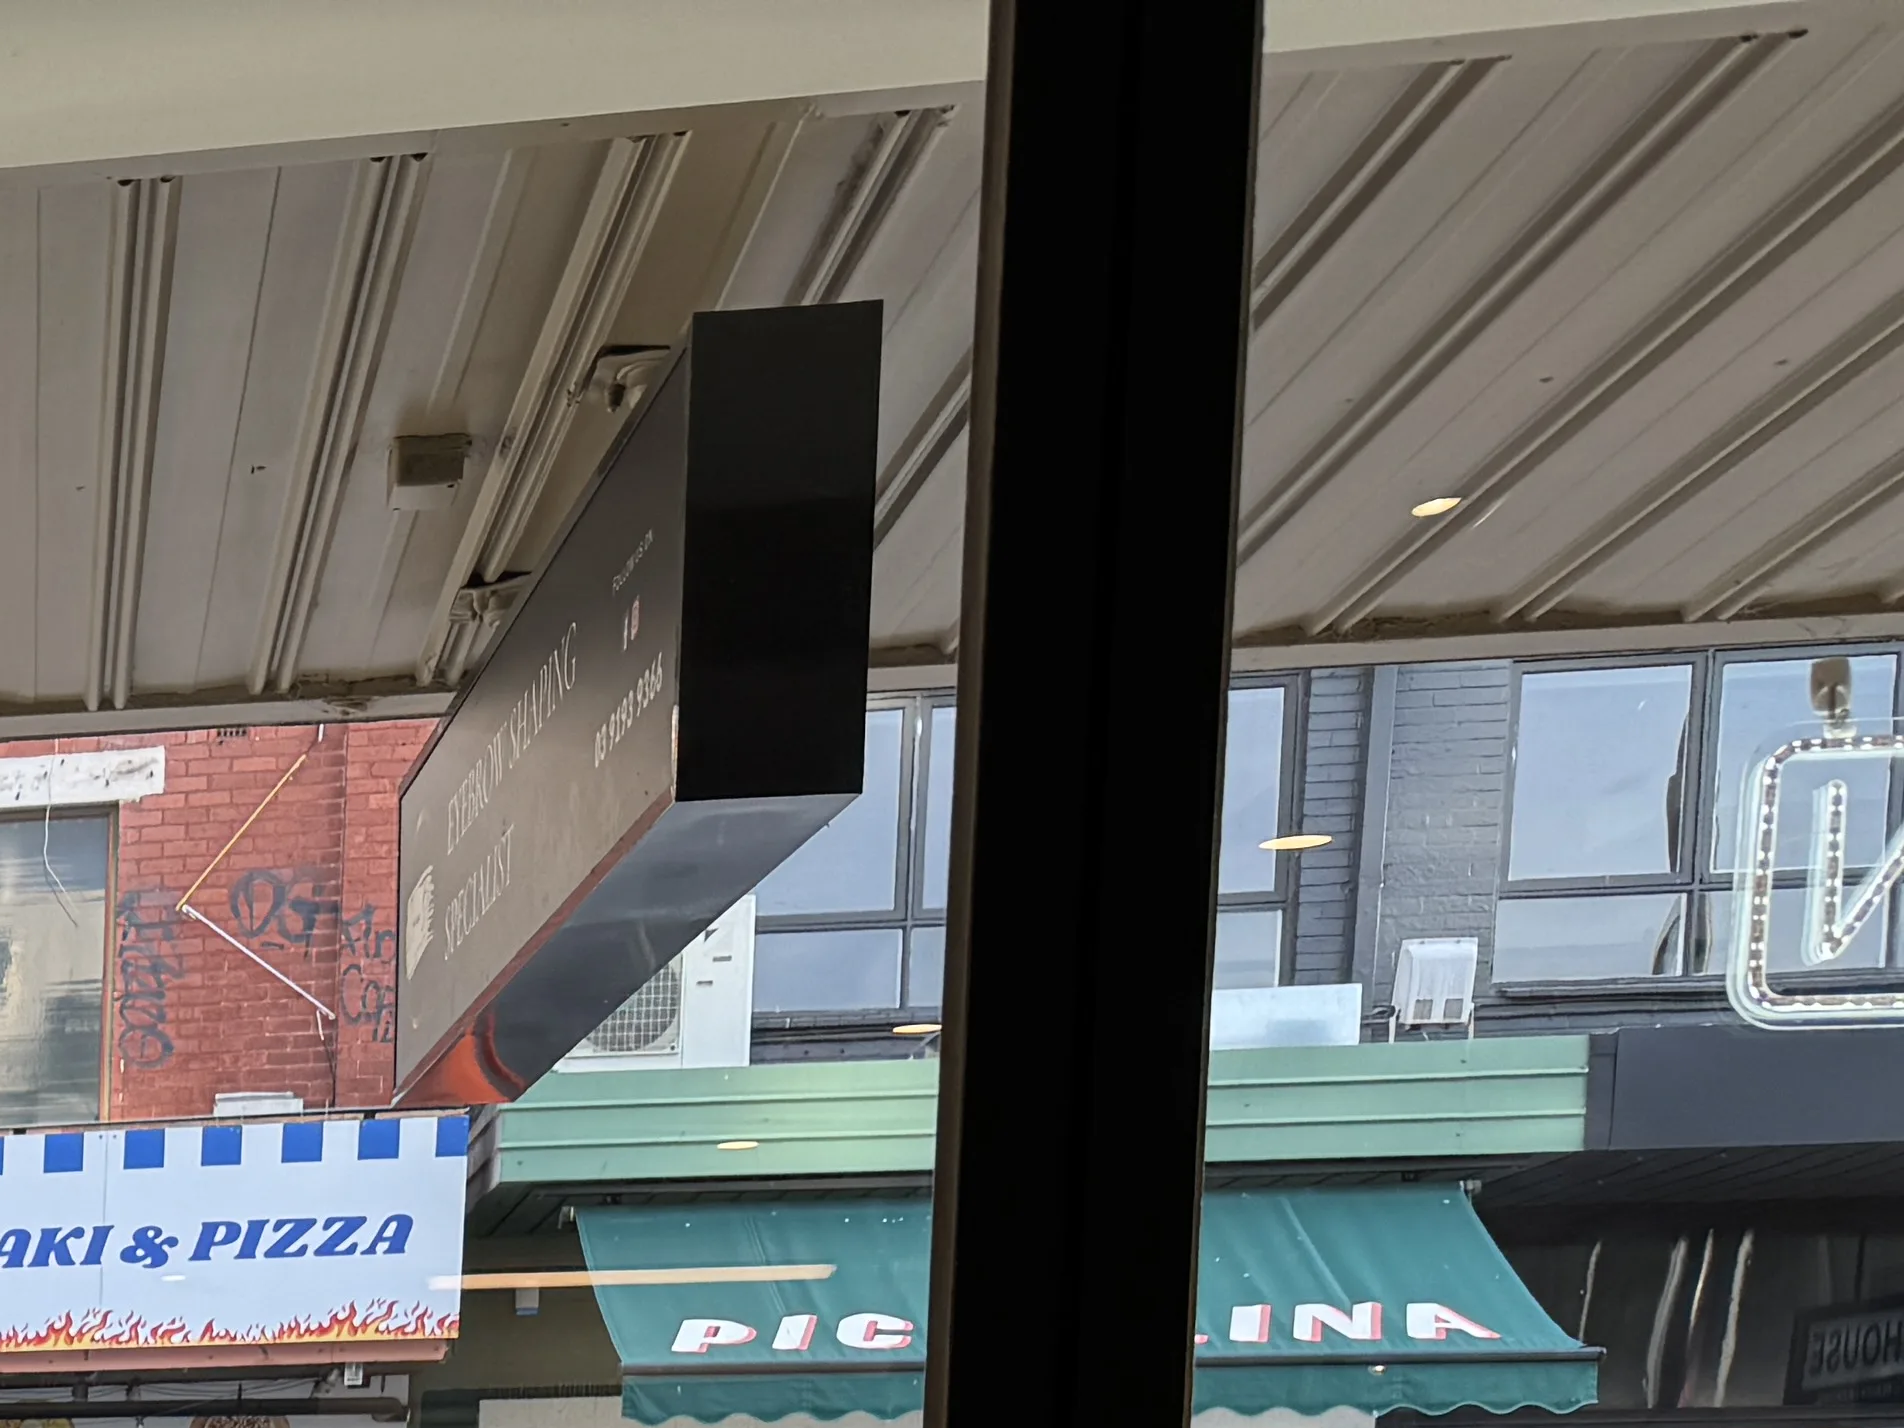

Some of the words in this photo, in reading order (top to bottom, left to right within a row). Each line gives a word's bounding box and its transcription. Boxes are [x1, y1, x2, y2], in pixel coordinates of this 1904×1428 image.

[446, 721, 505, 856] EYEBROW
[508, 622, 578, 770] SHAPING
[595, 723, 607, 768] 03
[609, 690, 634, 751] 9193
[444, 824, 514, 962] SPECIALIST
[120, 1226, 178, 1269] &
[188, 1213, 415, 1263] PIZZA
